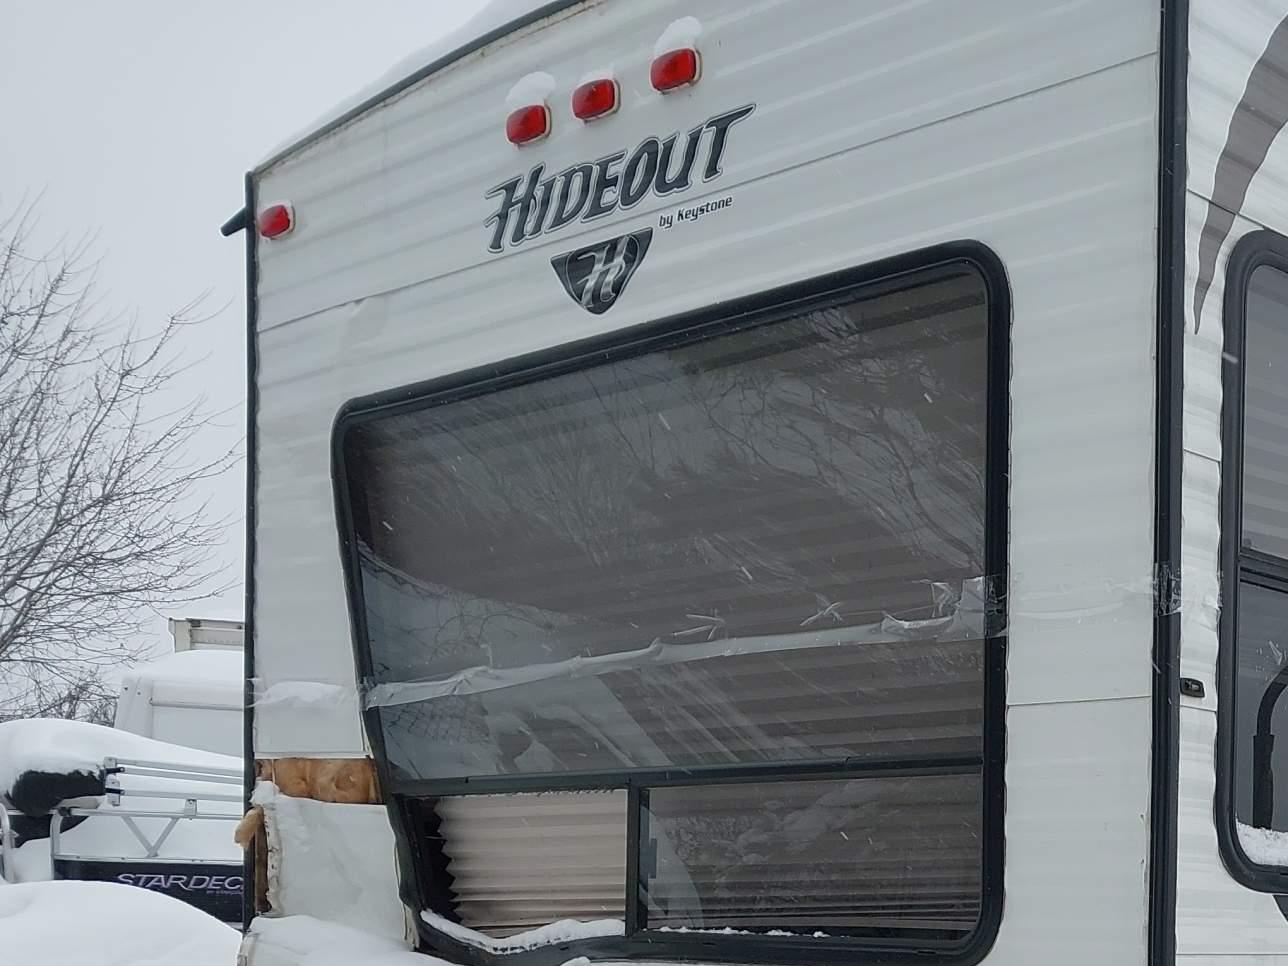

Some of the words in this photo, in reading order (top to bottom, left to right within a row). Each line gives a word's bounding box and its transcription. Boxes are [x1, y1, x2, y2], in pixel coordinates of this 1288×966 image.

[484, 103, 757, 253] HIDEOUT
[658, 215, 674, 229] by
[677, 196, 733, 222] Keystone
